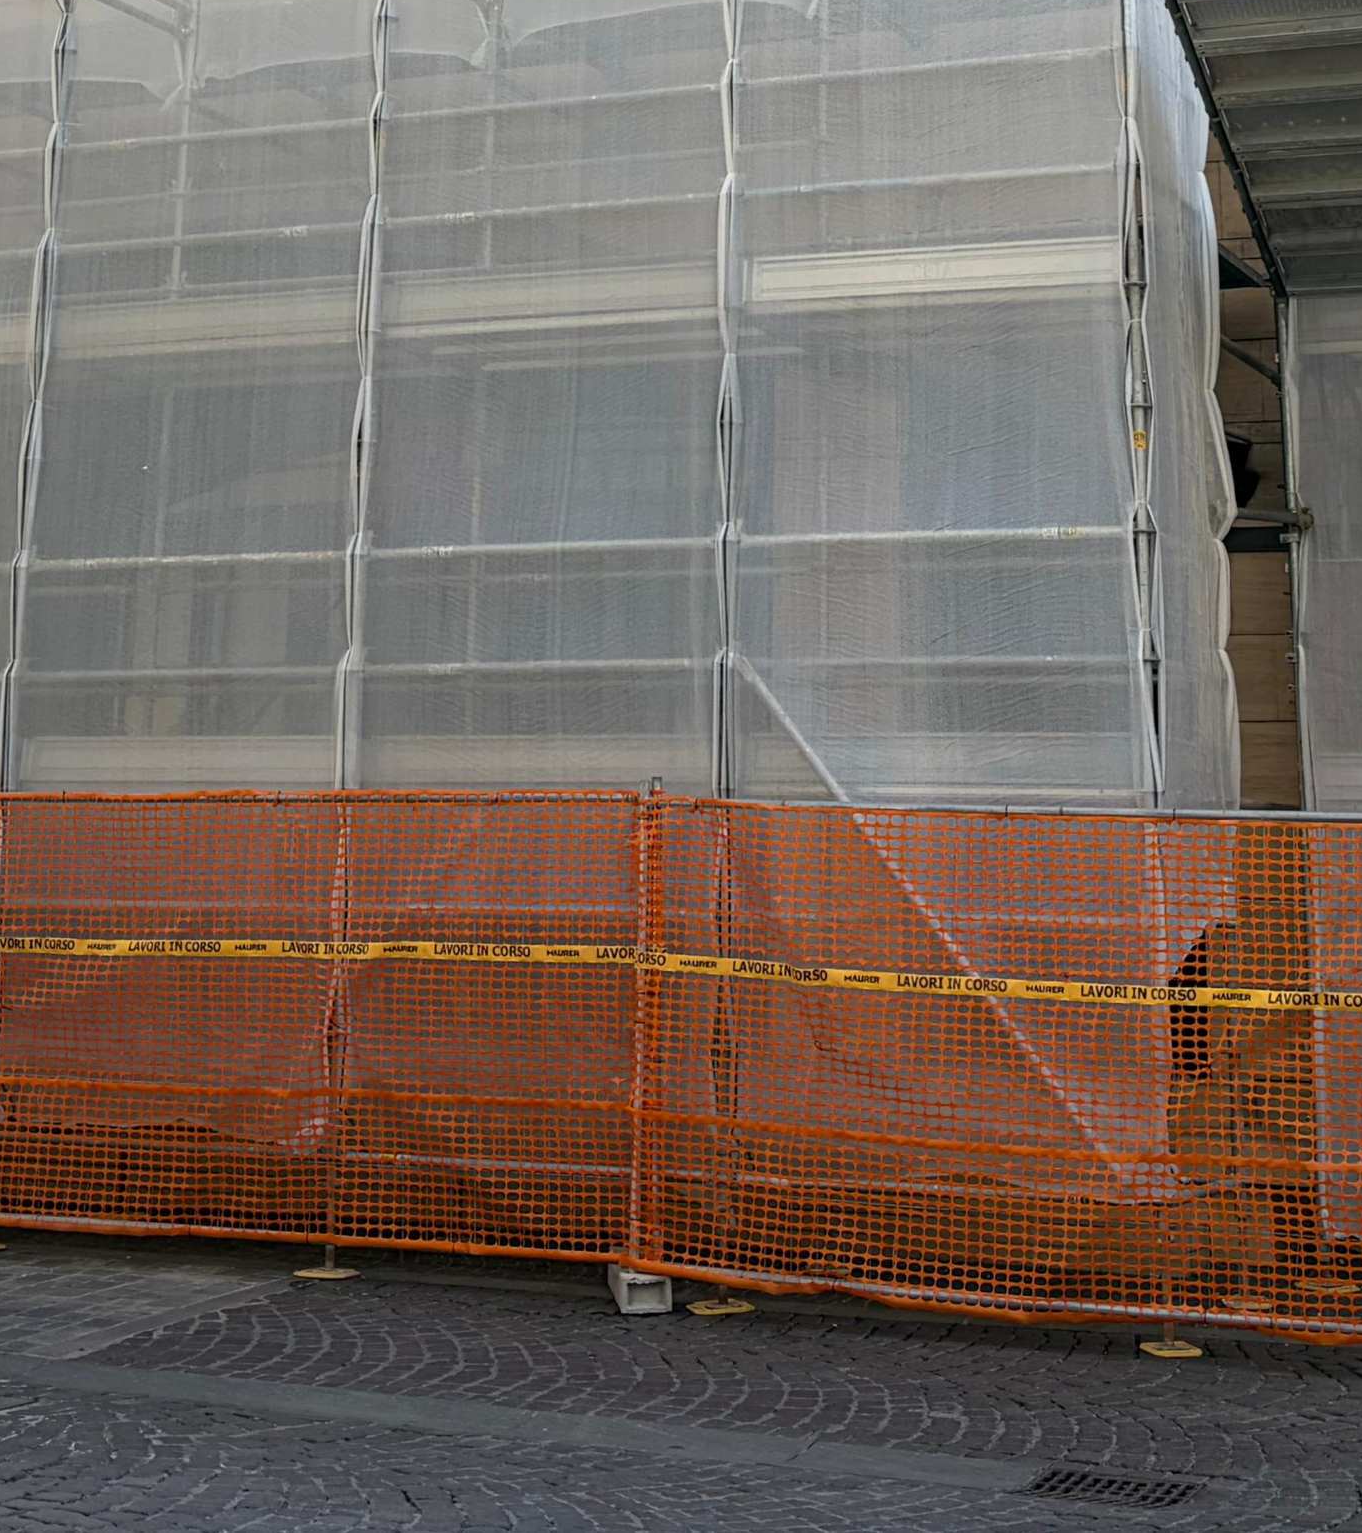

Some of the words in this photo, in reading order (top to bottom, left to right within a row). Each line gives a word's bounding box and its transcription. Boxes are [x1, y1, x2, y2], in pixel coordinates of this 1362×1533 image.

[29, 939, 42, 949] IN
[45, 939, 75, 950] CORSO
[129, 941, 165, 951] LAVORI
[170, 941, 182, 951] IN
[185, 941, 221, 953] CORSO
[282, 942, 319, 954] LAVORI
[324, 944, 334, 954] IN
[336, 944, 369, 955] CORSO
[383, 945, 418, 953] MAURER
[434, 945, 473, 955] LAVORI
[477, 945, 488, 955] IN
[492, 946, 530, 957] CORSO
[547, 949, 579, 957] MAURER
[680, 960, 717, 969] MAURER
[733, 961, 775, 975] LAVORI
[779, 963, 791, 976] IN
[844, 975, 880, 983] MAURER
[897, 975, 943, 988] LAVORI
[948, 977, 961, 989] IN
[965, 979, 1007, 992] CORSO
[1026, 985, 1064, 993] MAURER
[1081, 985, 1127, 998] LAVORI
[1133, 986, 1147, 998] IN
[1151, 988, 1197, 1001] CORSO
[1268, 993, 1319, 1005] LAVORI
[1324, 994, 1340, 1006] IN
